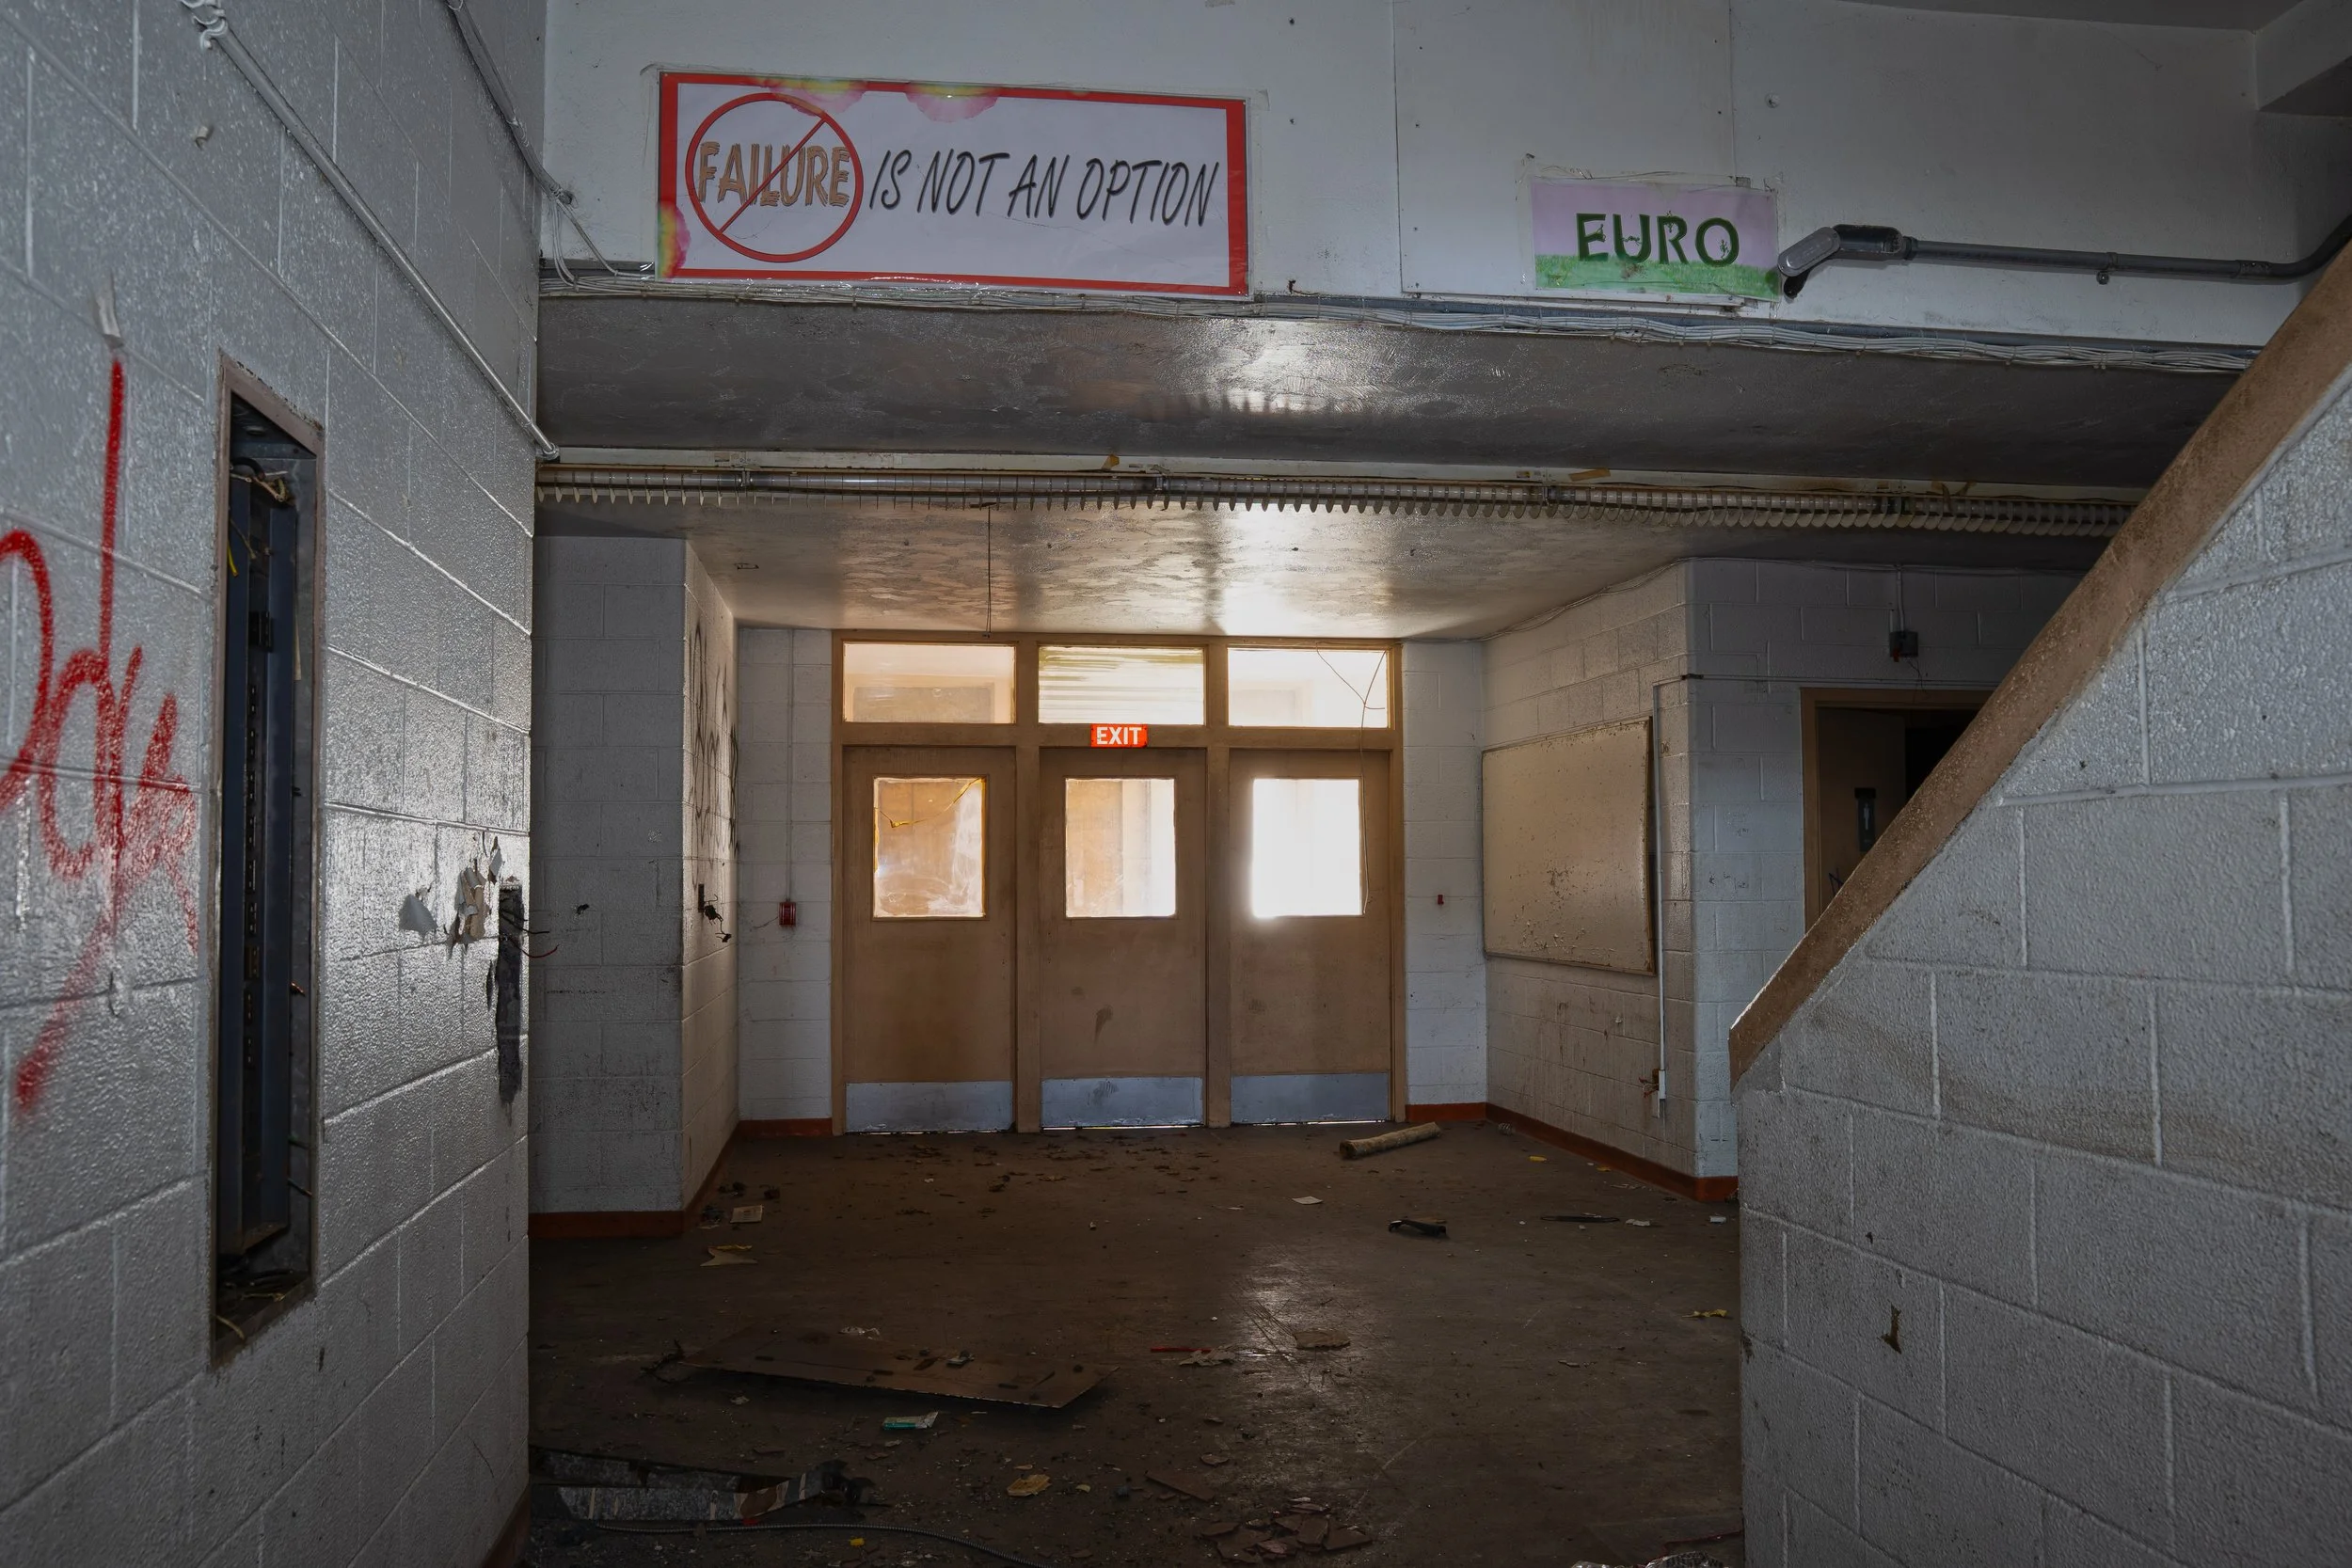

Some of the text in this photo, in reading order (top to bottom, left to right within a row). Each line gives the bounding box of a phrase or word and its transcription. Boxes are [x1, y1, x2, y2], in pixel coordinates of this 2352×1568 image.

[696, 142, 1220, 228] FAILURE IS NOT AN OPTION
[1576, 213, 1740, 266] EURO
[1096, 726, 1142, 745] EXIT
